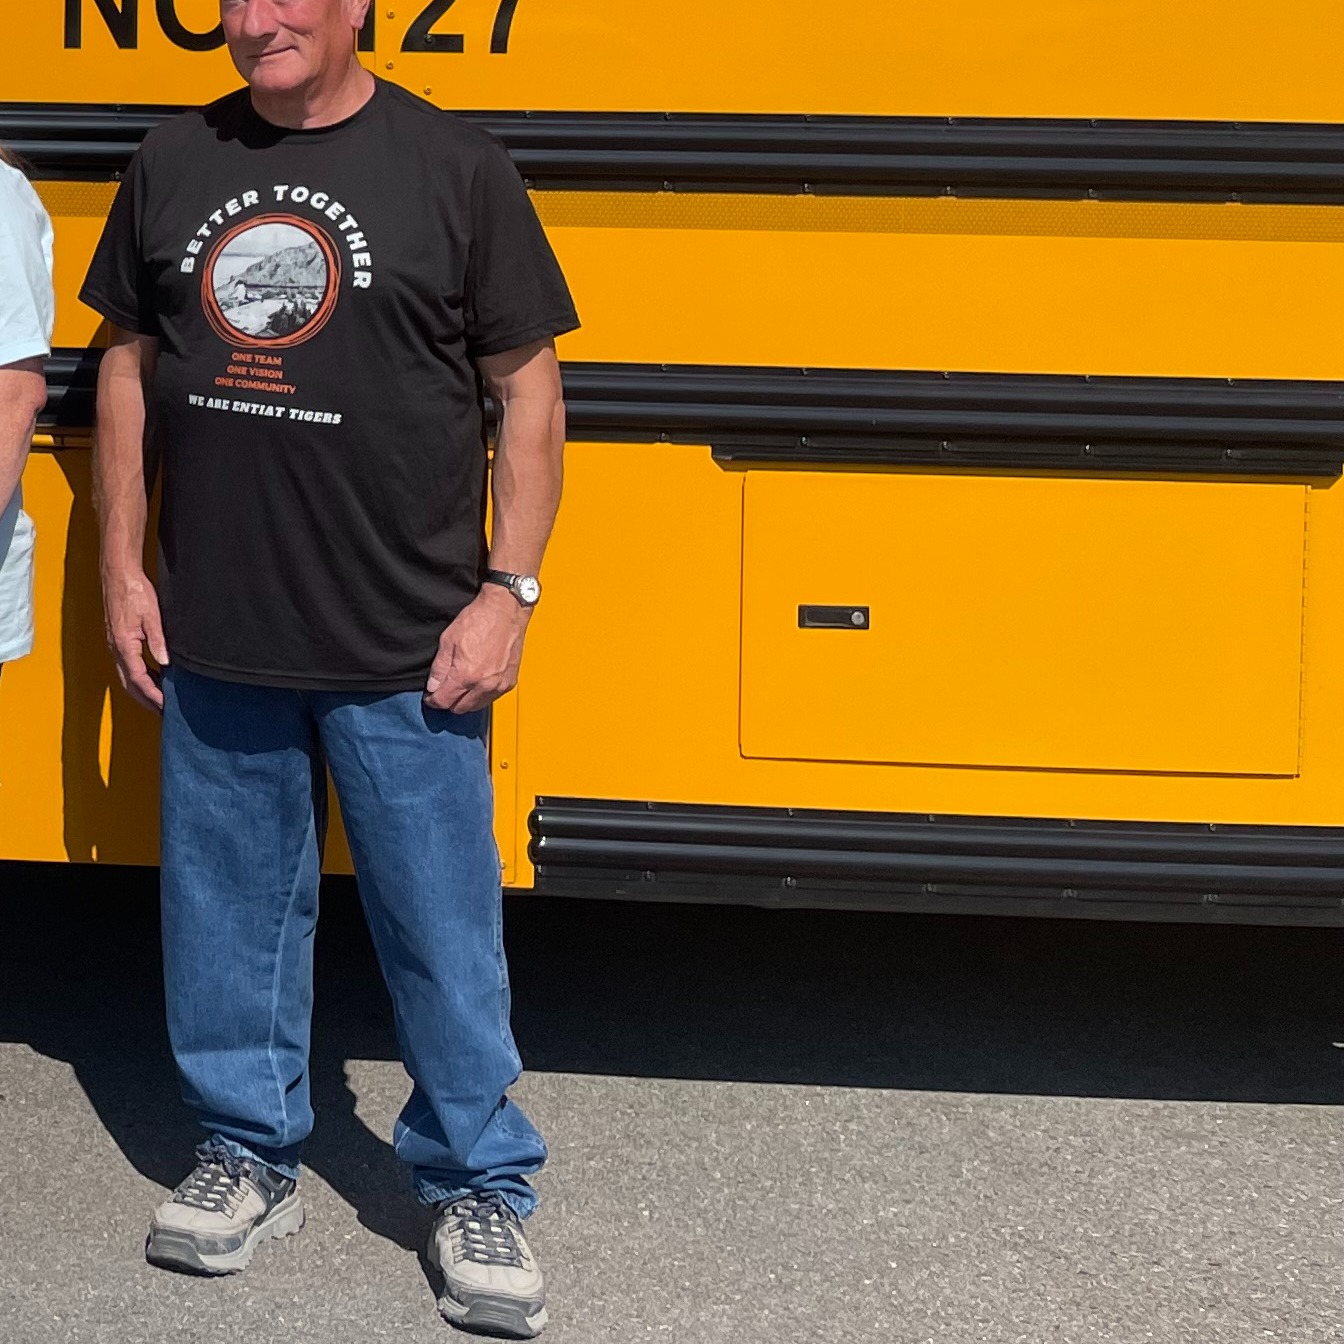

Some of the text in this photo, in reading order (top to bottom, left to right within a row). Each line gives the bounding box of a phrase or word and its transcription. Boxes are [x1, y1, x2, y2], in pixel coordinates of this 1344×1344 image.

[180, 184, 373, 290] BETTER TOGETHER
[231, 352, 283, 366] ONE TEAM
[226, 365, 284, 379] ONE VISION
[214, 377, 297, 394] ONE COMMUNITY
[188, 394, 342, 425] WE ARE ENTIAT TIGERS
